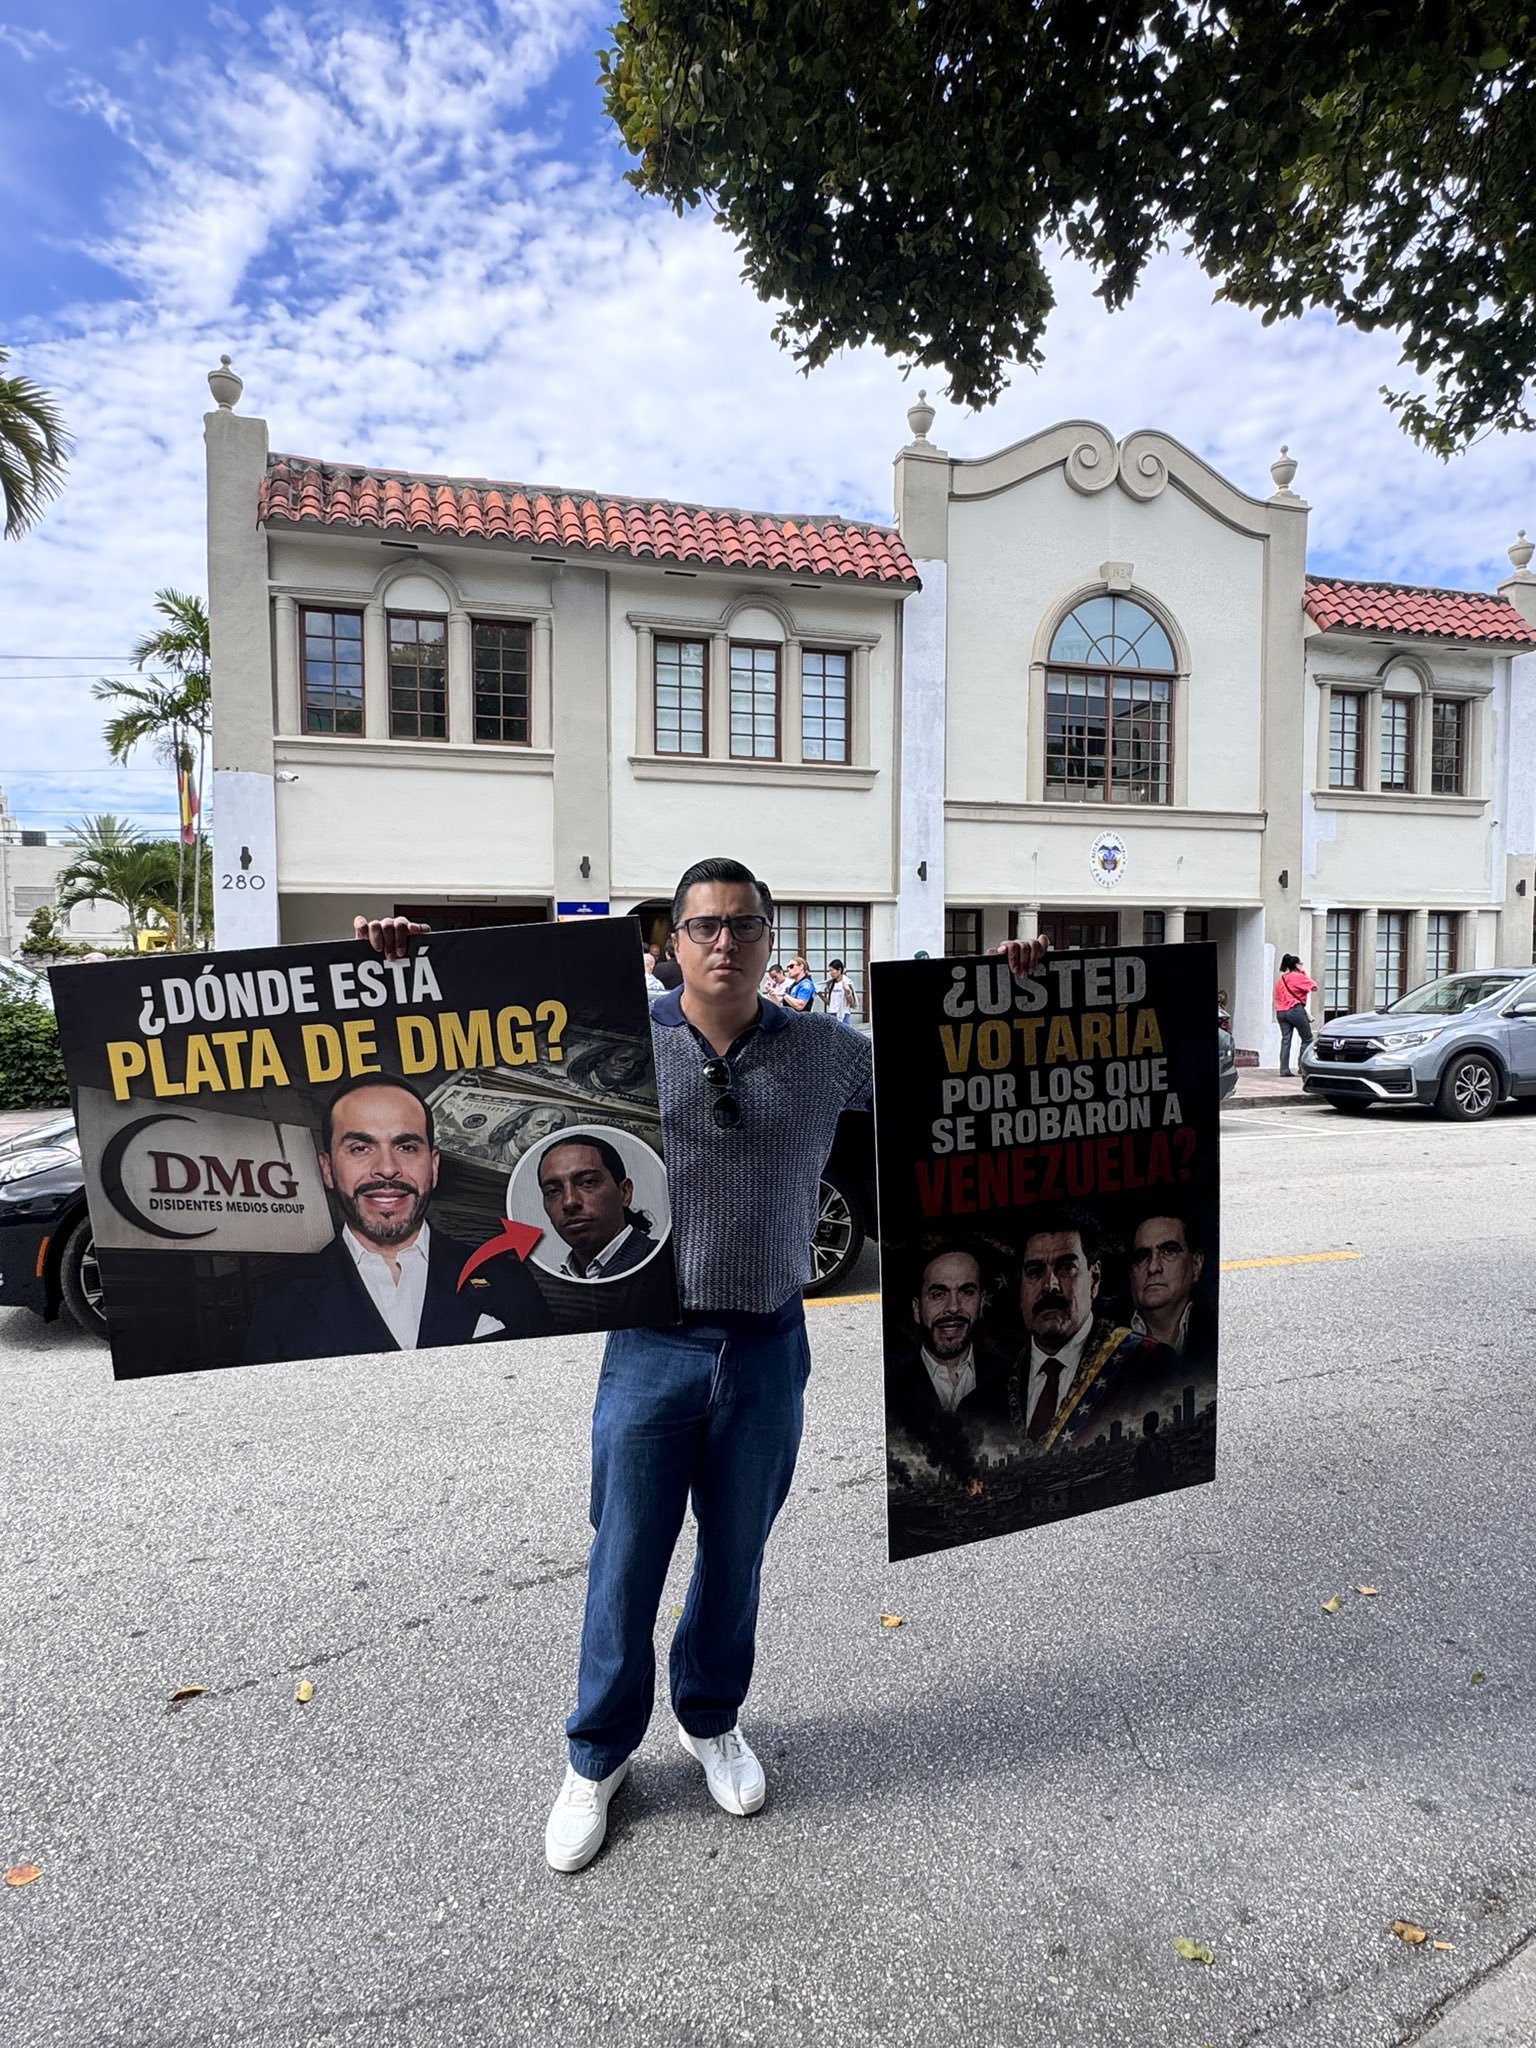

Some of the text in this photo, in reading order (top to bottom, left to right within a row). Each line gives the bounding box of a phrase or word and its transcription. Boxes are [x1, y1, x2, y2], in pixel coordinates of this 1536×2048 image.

[222, 874, 265, 890] 280
[138, 945, 443, 1036] ¿DÓNDE ESTÁ
[943, 956, 1147, 1018] ¿USTED
[106, 999, 568, 1101] PLATA DE DMG?
[939, 1004, 1164, 1073] VOTARÍA
[942, 1057, 1168, 1115] POR LOS QUE
[931, 1115, 976, 1154] SE
[1162, 1093, 1183, 1125] A
[147, 1150, 299, 1199] DMG
[914, 1127, 1197, 1217] VENEZUELA?
[149, 1198, 305, 1214] DISIDENTES MEDIOS GROUP
